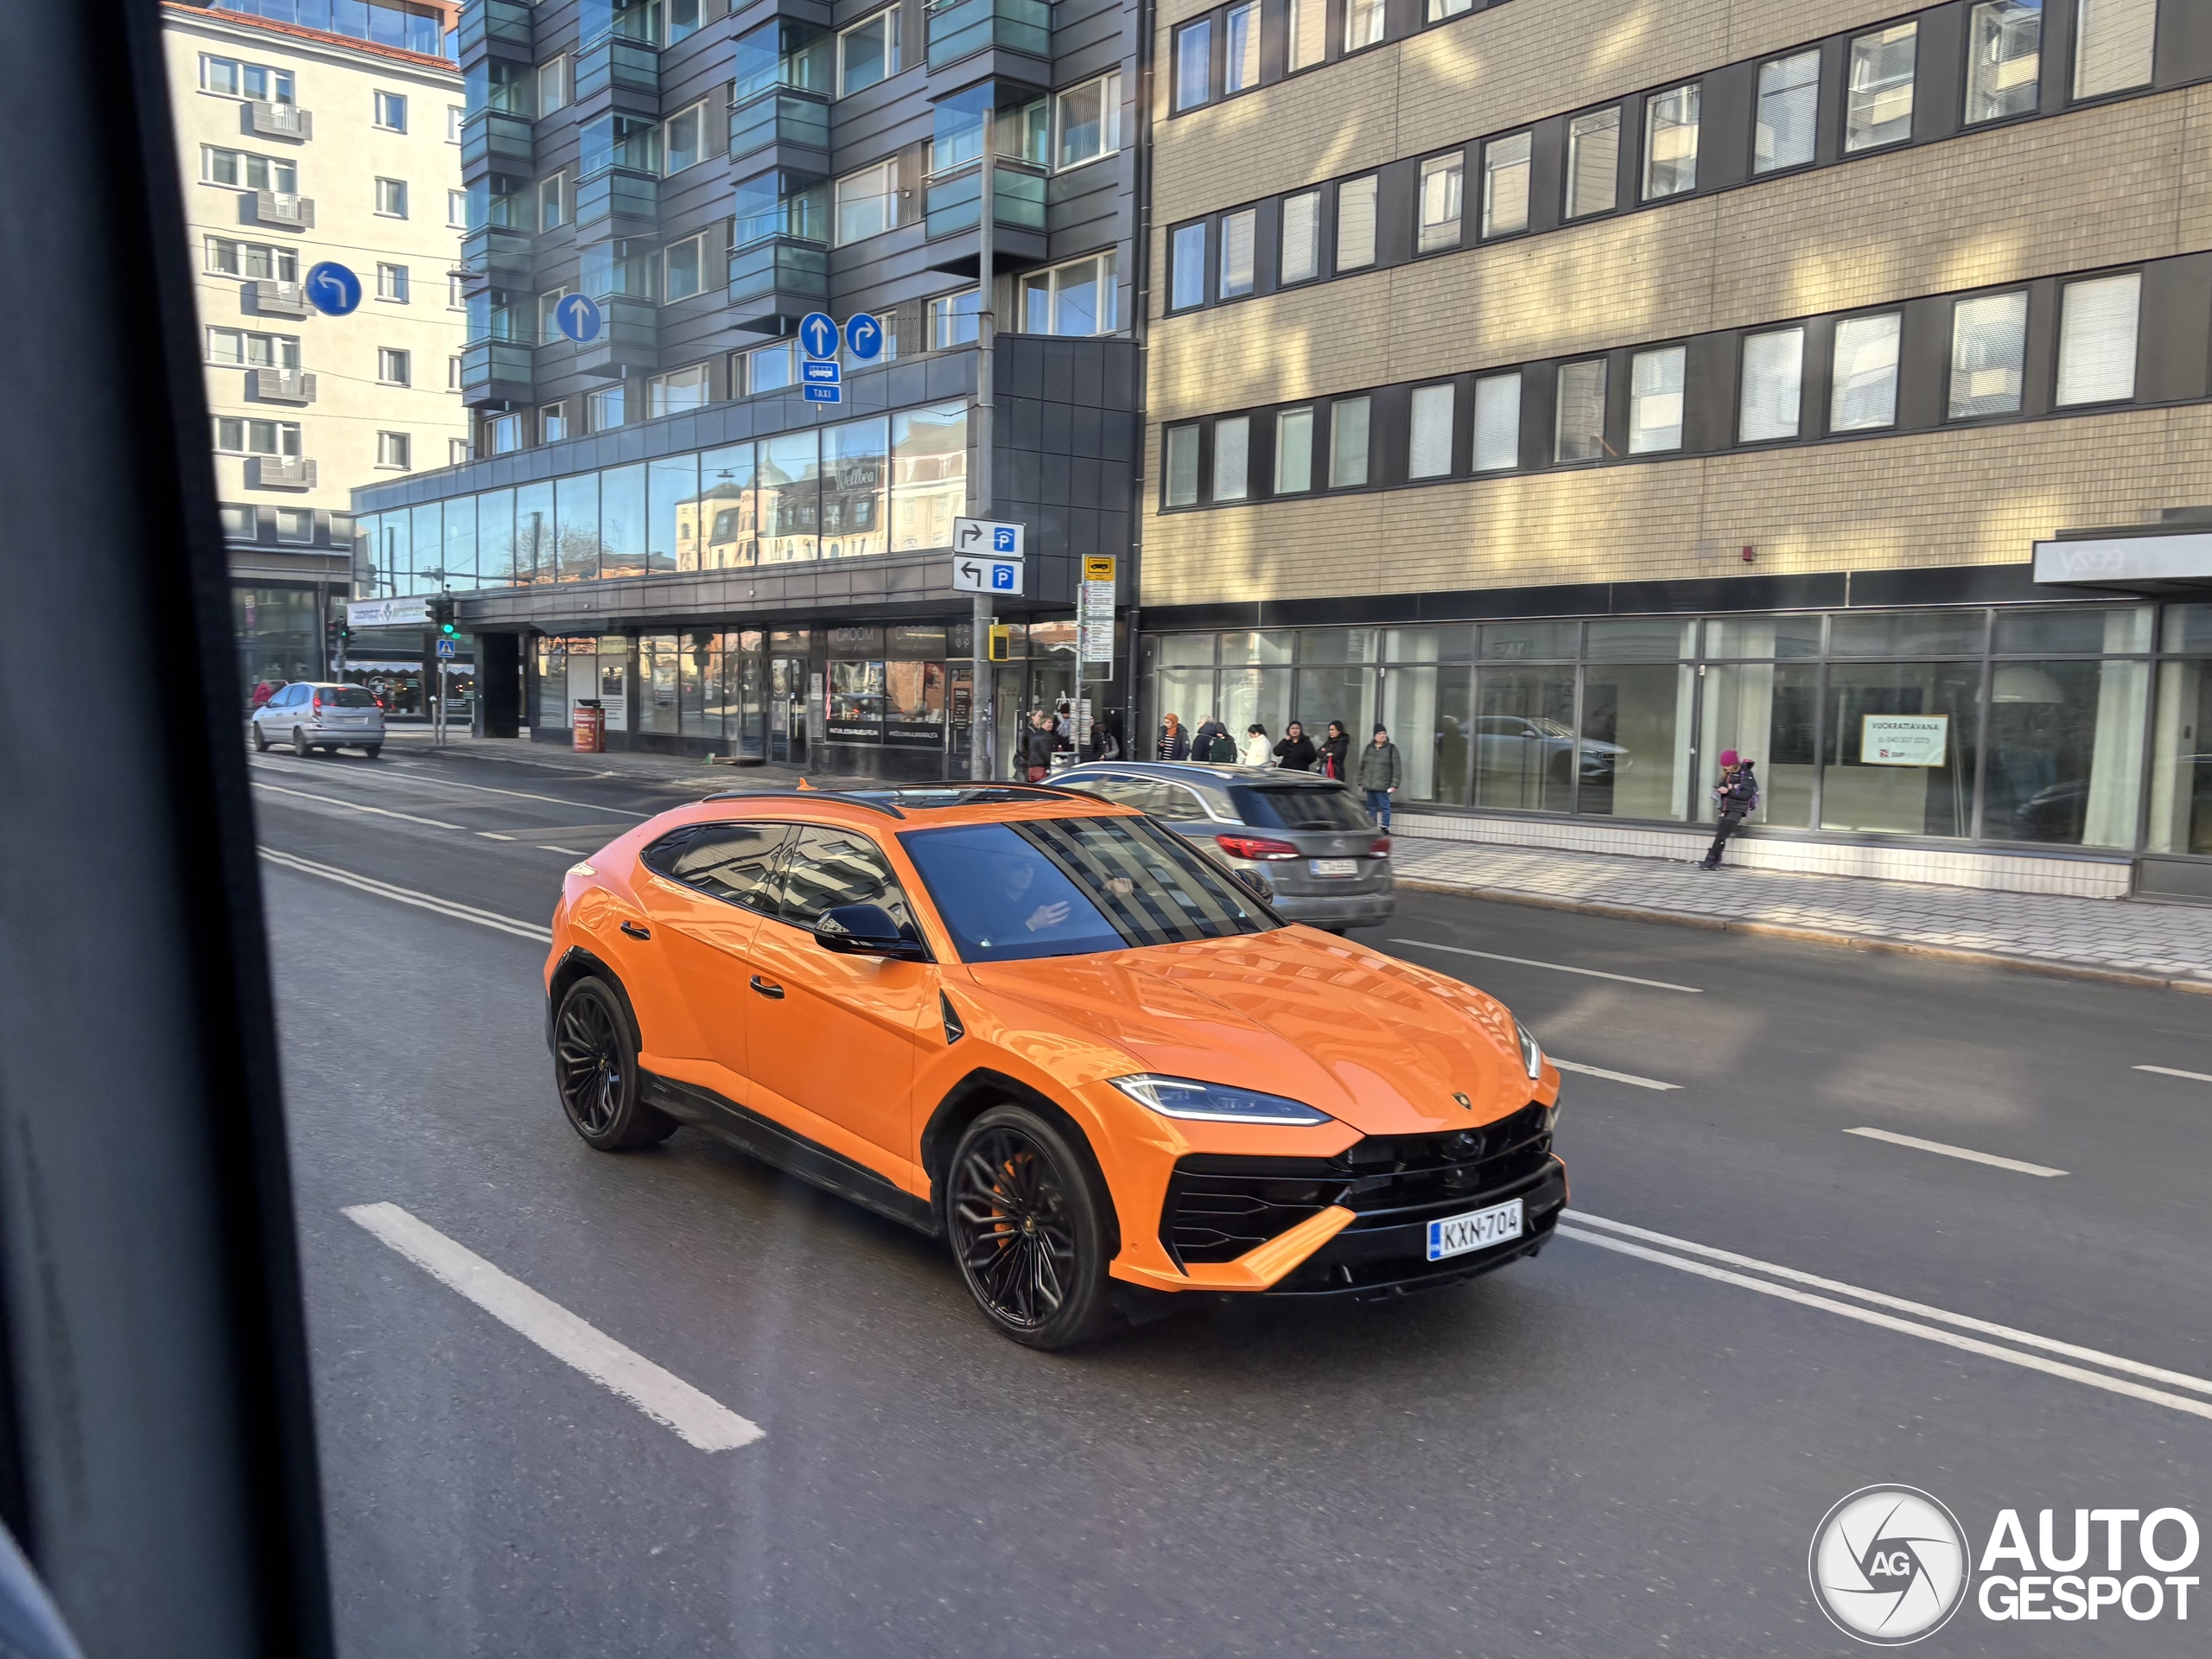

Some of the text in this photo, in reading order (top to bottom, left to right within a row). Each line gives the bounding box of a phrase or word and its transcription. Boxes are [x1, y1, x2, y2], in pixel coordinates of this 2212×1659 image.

[813, 389, 831, 398] TAXI
[1000, 535, 1009, 549] P
[998, 572, 1008, 586] P
[836, 627, 874, 641] GROOM
[1444, 1208, 1518, 1250] KXN-704
